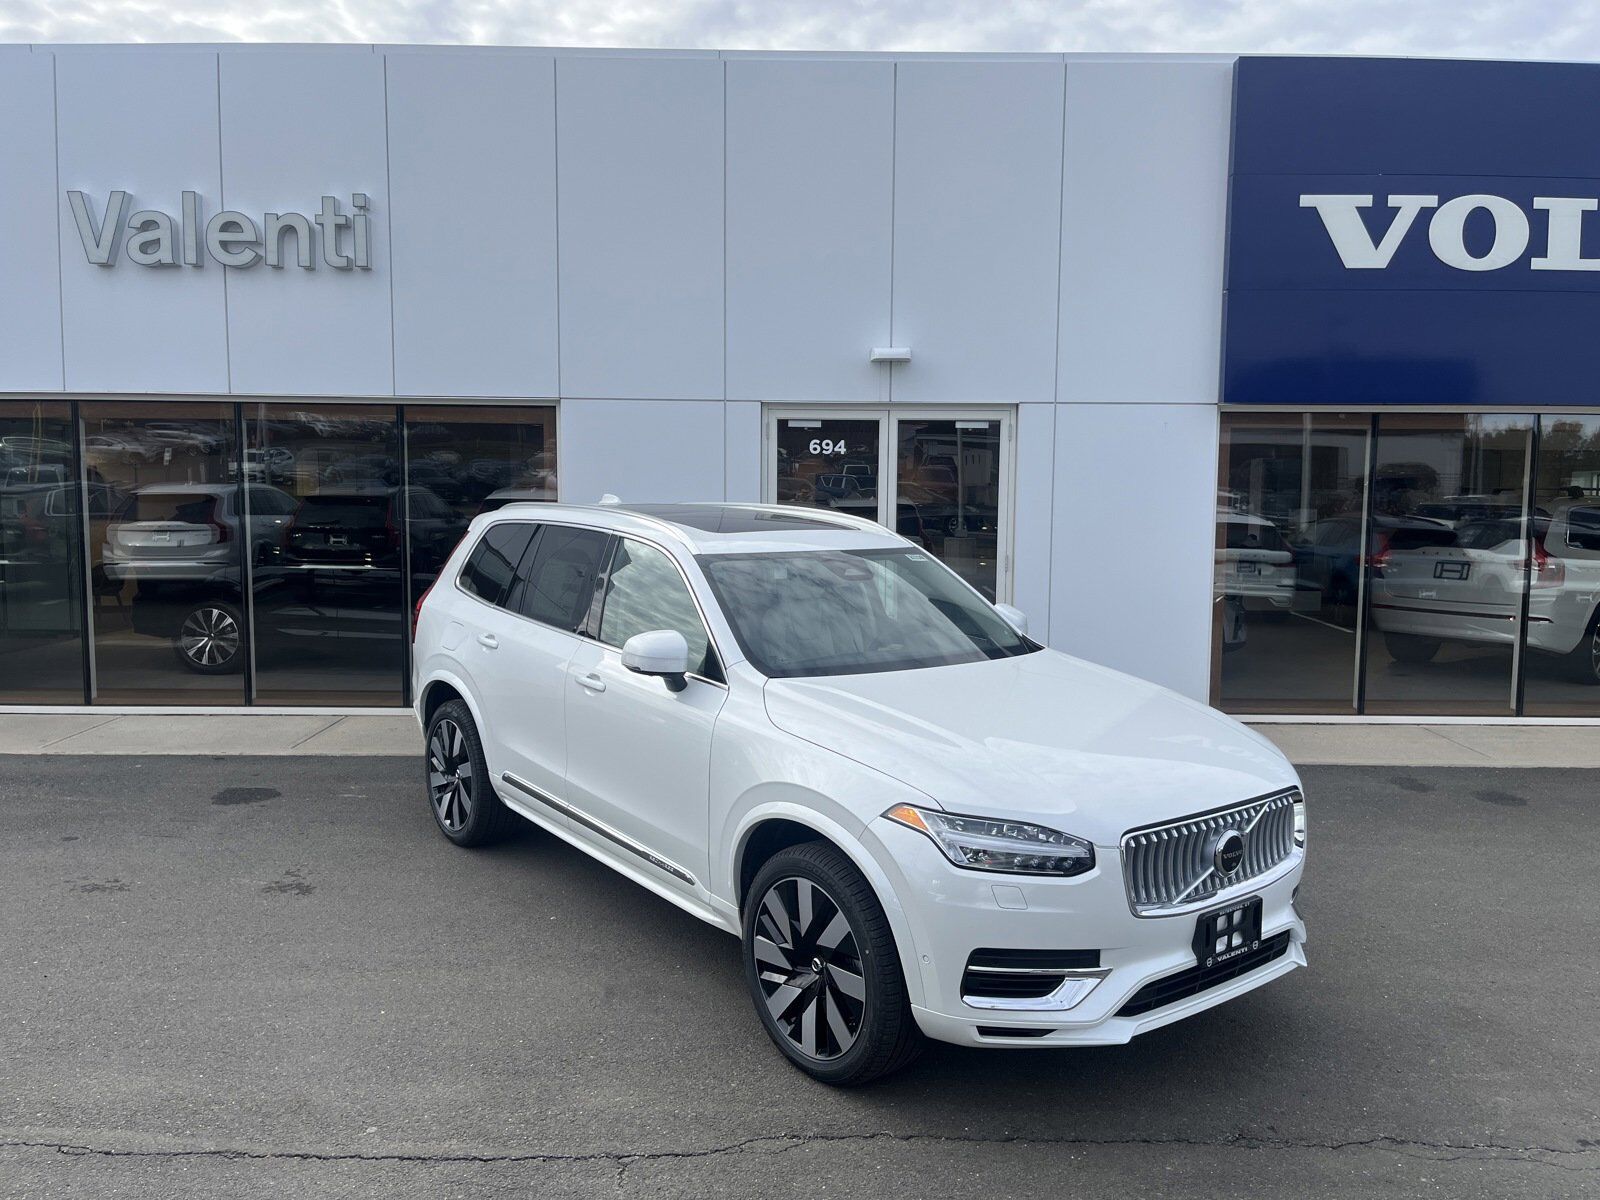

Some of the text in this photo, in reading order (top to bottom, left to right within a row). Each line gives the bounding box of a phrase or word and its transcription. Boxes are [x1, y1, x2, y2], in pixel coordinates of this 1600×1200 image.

[67, 190, 371, 269] Valenti
[1299, 194, 1600, 271] VOL
[809, 439, 847, 455] 694
[1217, 947, 1248, 962] VALENTI
